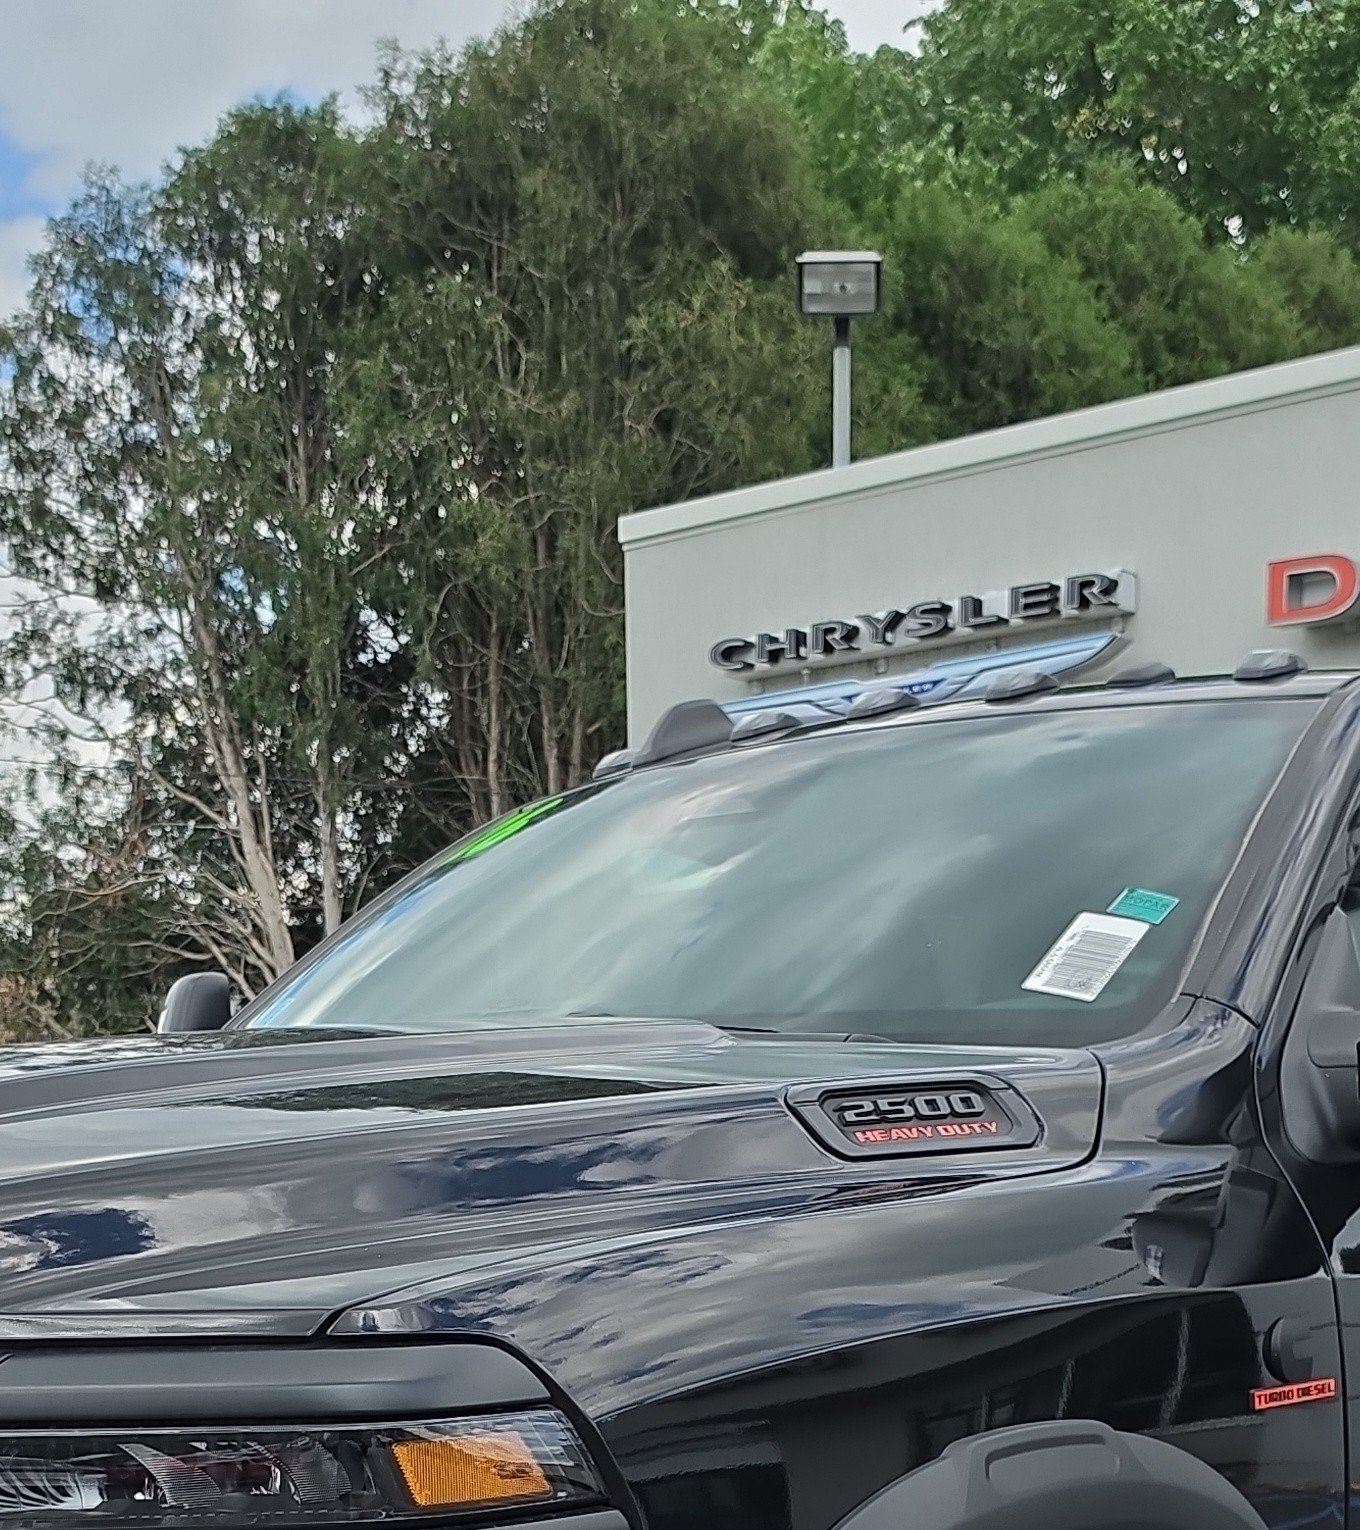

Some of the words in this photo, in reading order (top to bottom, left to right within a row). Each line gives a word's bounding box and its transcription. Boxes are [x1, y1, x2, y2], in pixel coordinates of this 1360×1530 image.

[709, 573, 1122, 671] CHRYSLER
[840, 1092, 986, 1124] 2500
[854, 1127, 935, 1144] HEAVY
[938, 1121, 999, 1138] DUTY
[1296, 1382, 1335, 1399] DIESEL
